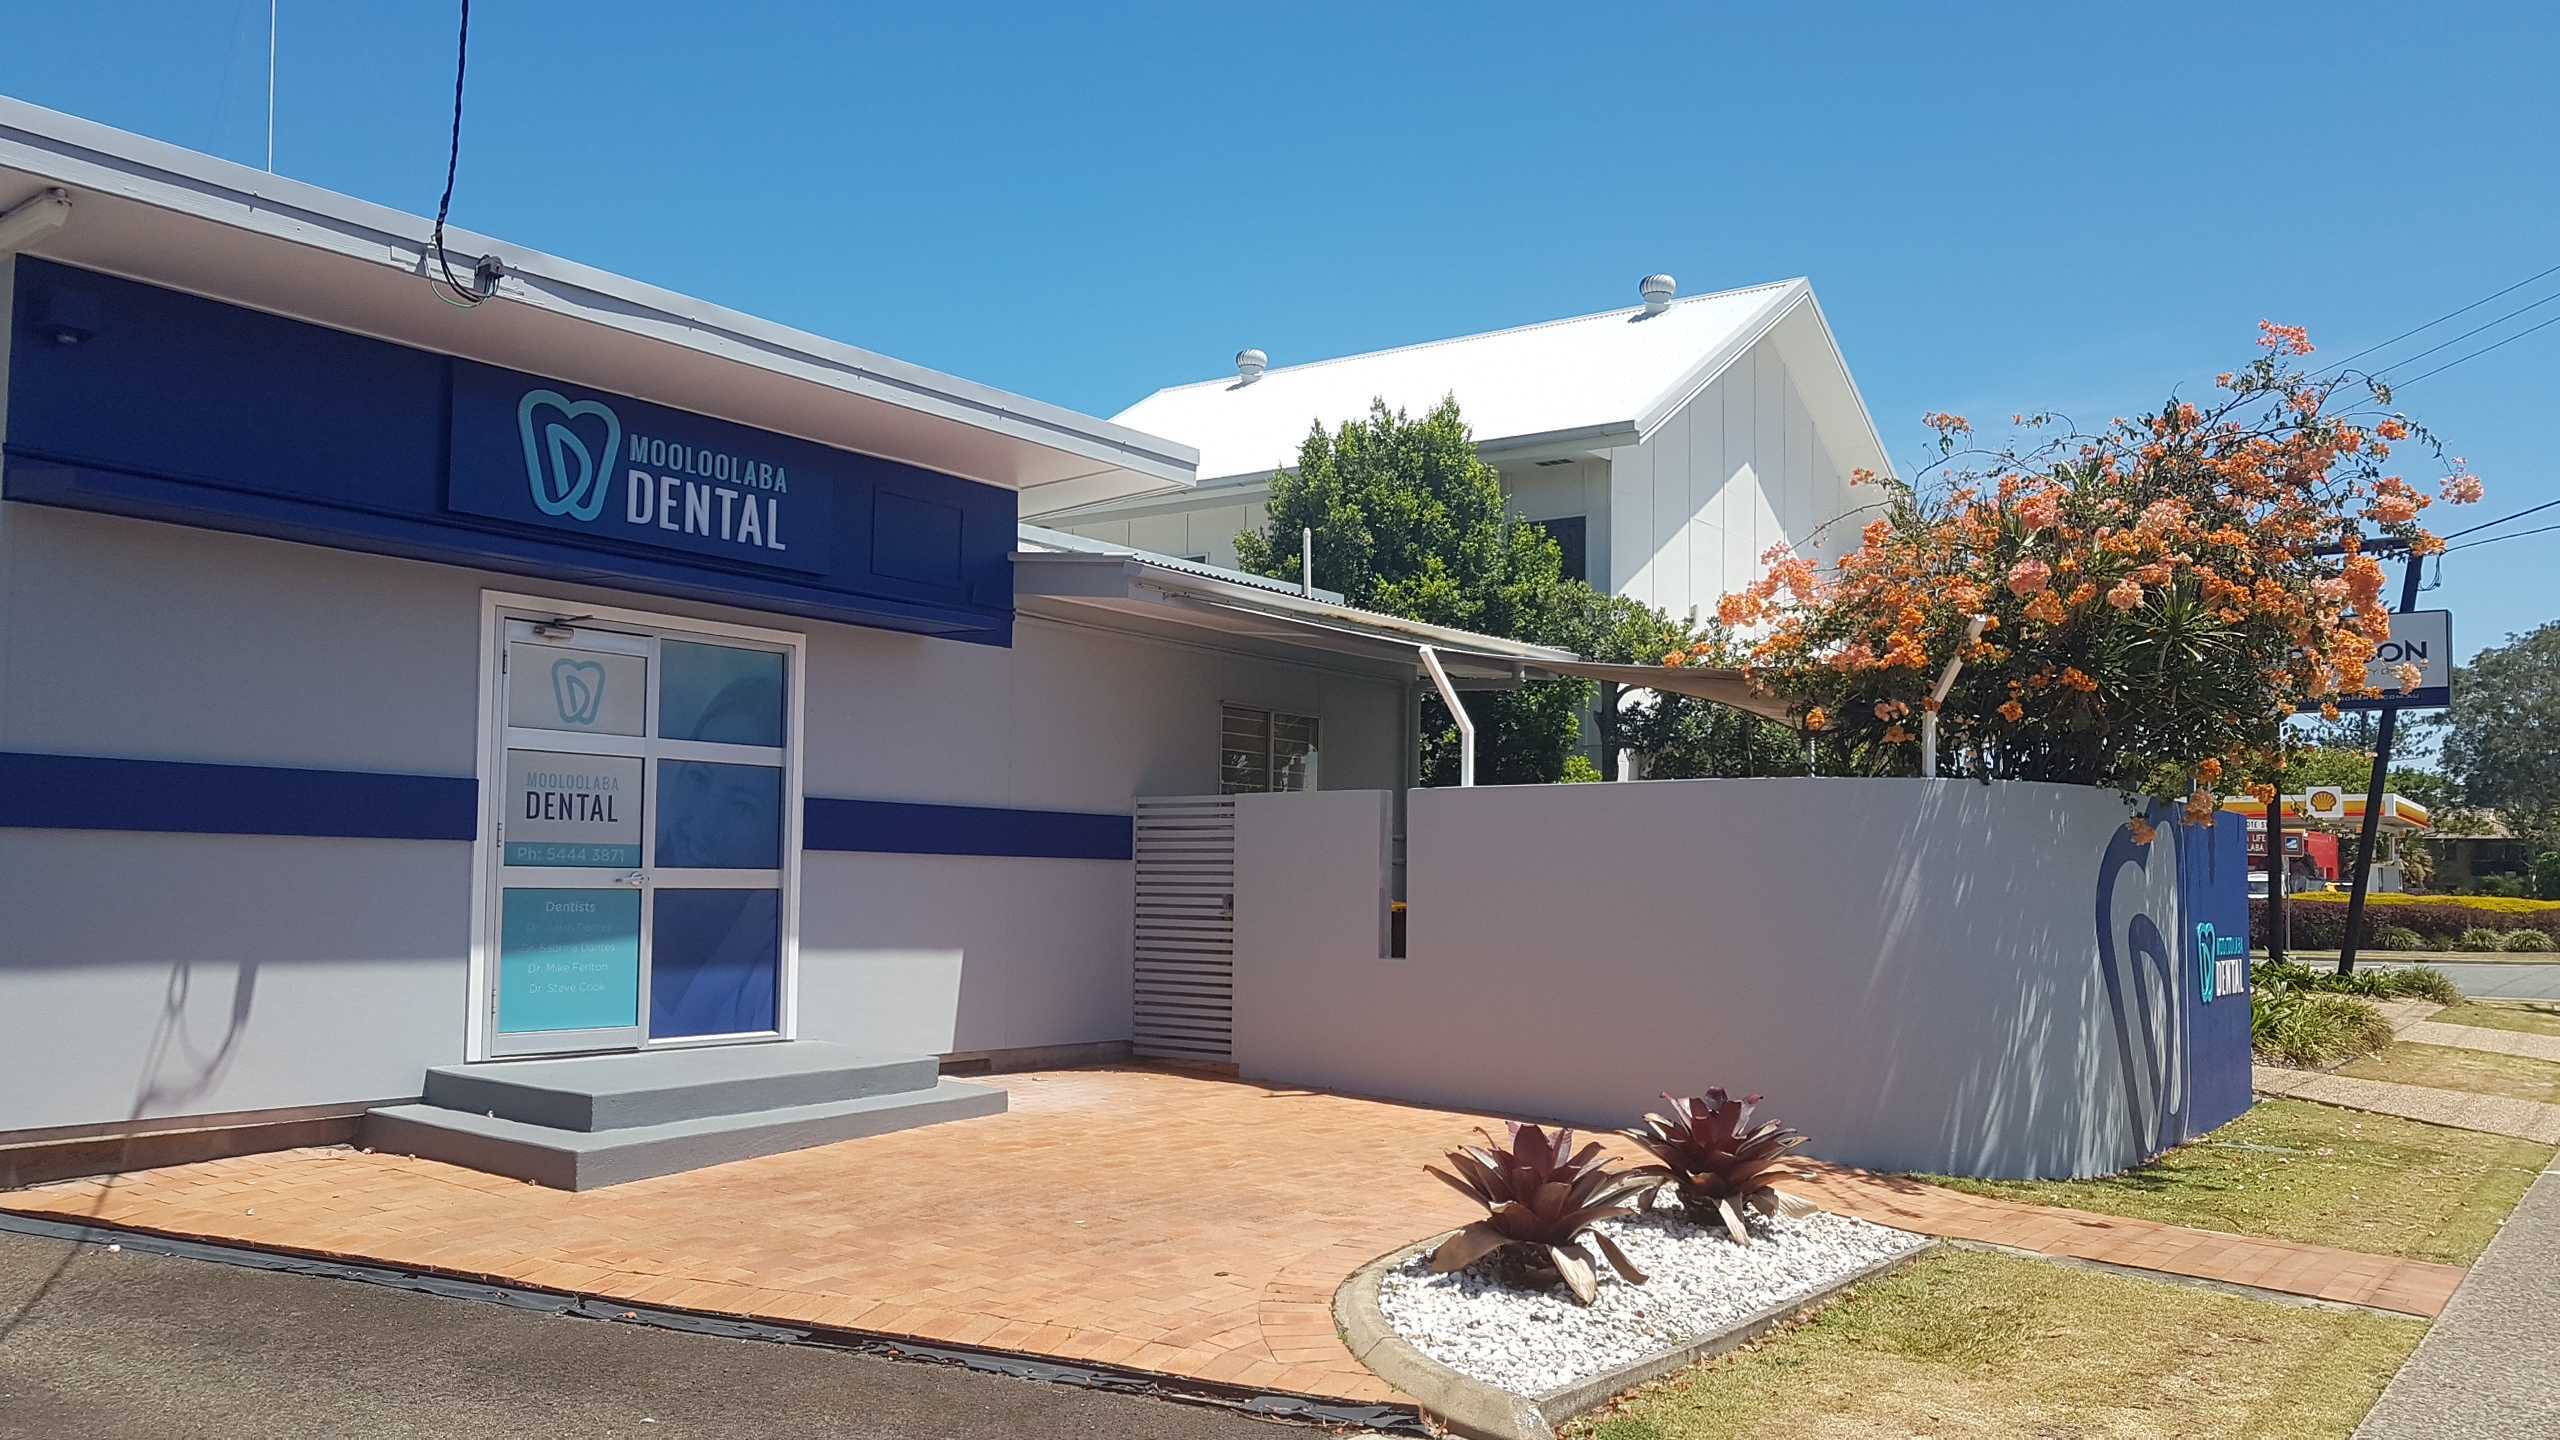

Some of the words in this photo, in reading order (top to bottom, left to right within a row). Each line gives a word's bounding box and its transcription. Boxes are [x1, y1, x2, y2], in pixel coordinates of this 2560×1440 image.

[629, 433, 787, 493] MOOLOOLABA
[627, 469, 786, 550] DENTAL
[527, 772, 619, 791] MOOLOOLABA
[526, 791, 618, 822] DENTAL
[518, 847, 543, 860] Ph:
[547, 847, 587, 861] 5444
[592, 848, 625, 863] 3871
[545, 901, 597, 913] Dentists
[547, 983, 577, 993] Steve
[2215, 959, 2244, 997] DENTAL
